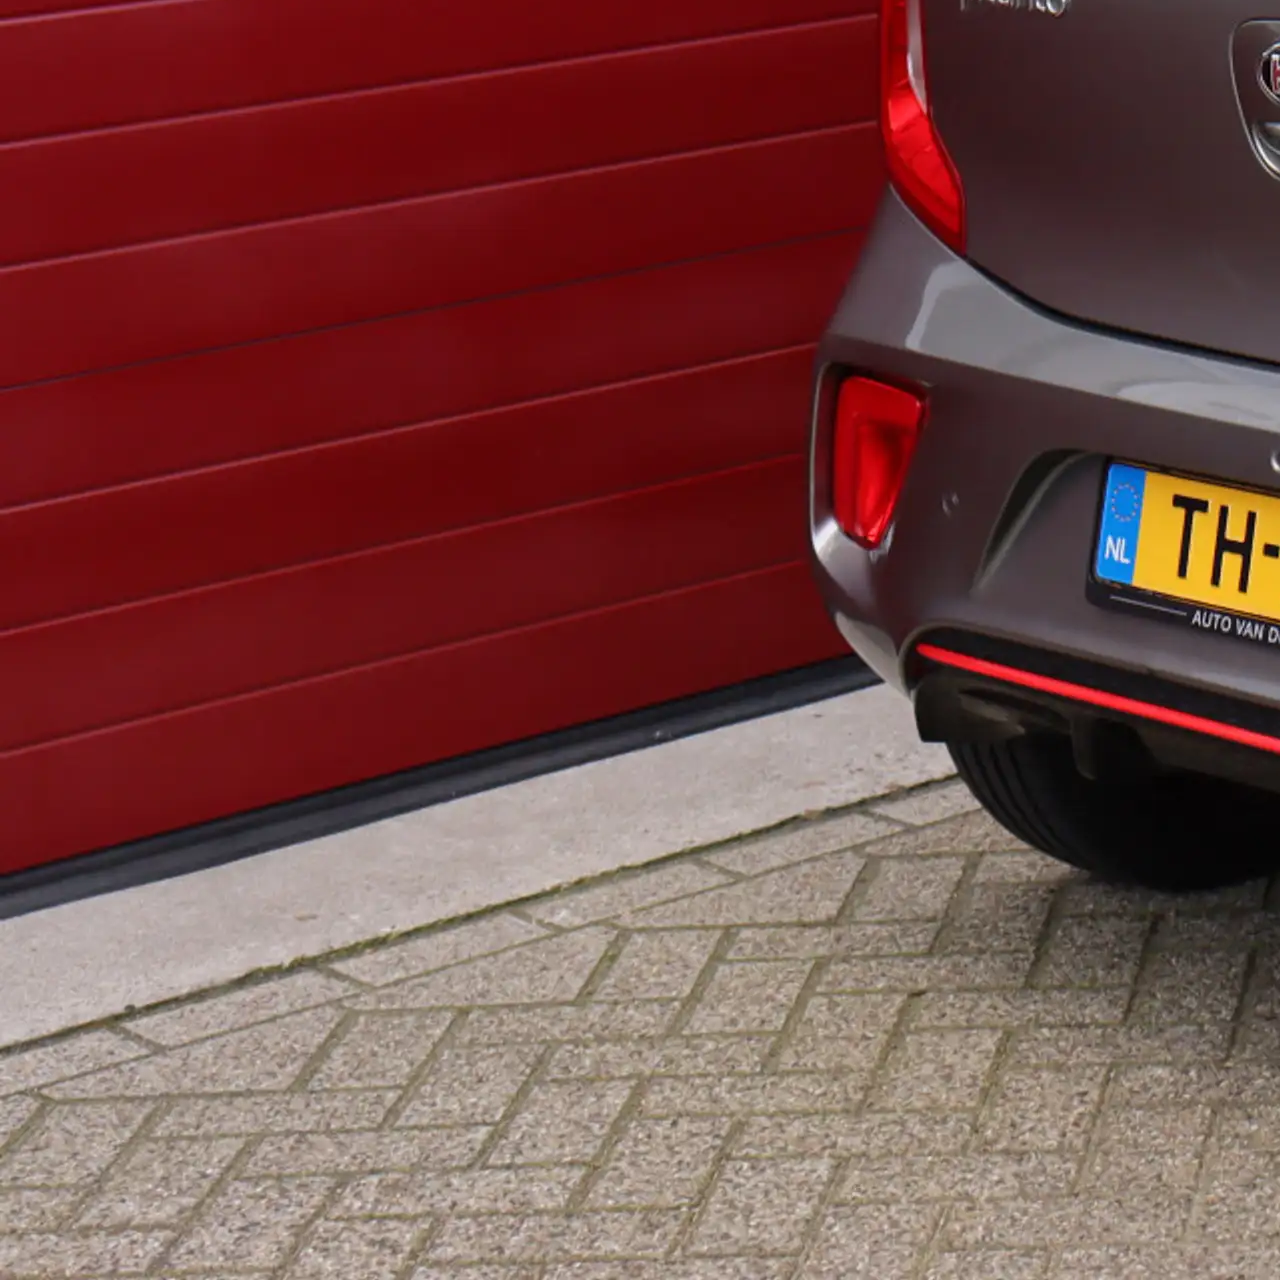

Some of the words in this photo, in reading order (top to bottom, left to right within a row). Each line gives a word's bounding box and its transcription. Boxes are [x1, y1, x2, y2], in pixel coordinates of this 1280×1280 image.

[1103, 533, 1131, 566] NL
[1191, 609, 1232, 633] AUTO
[1236, 618, 1266, 641] VAN
